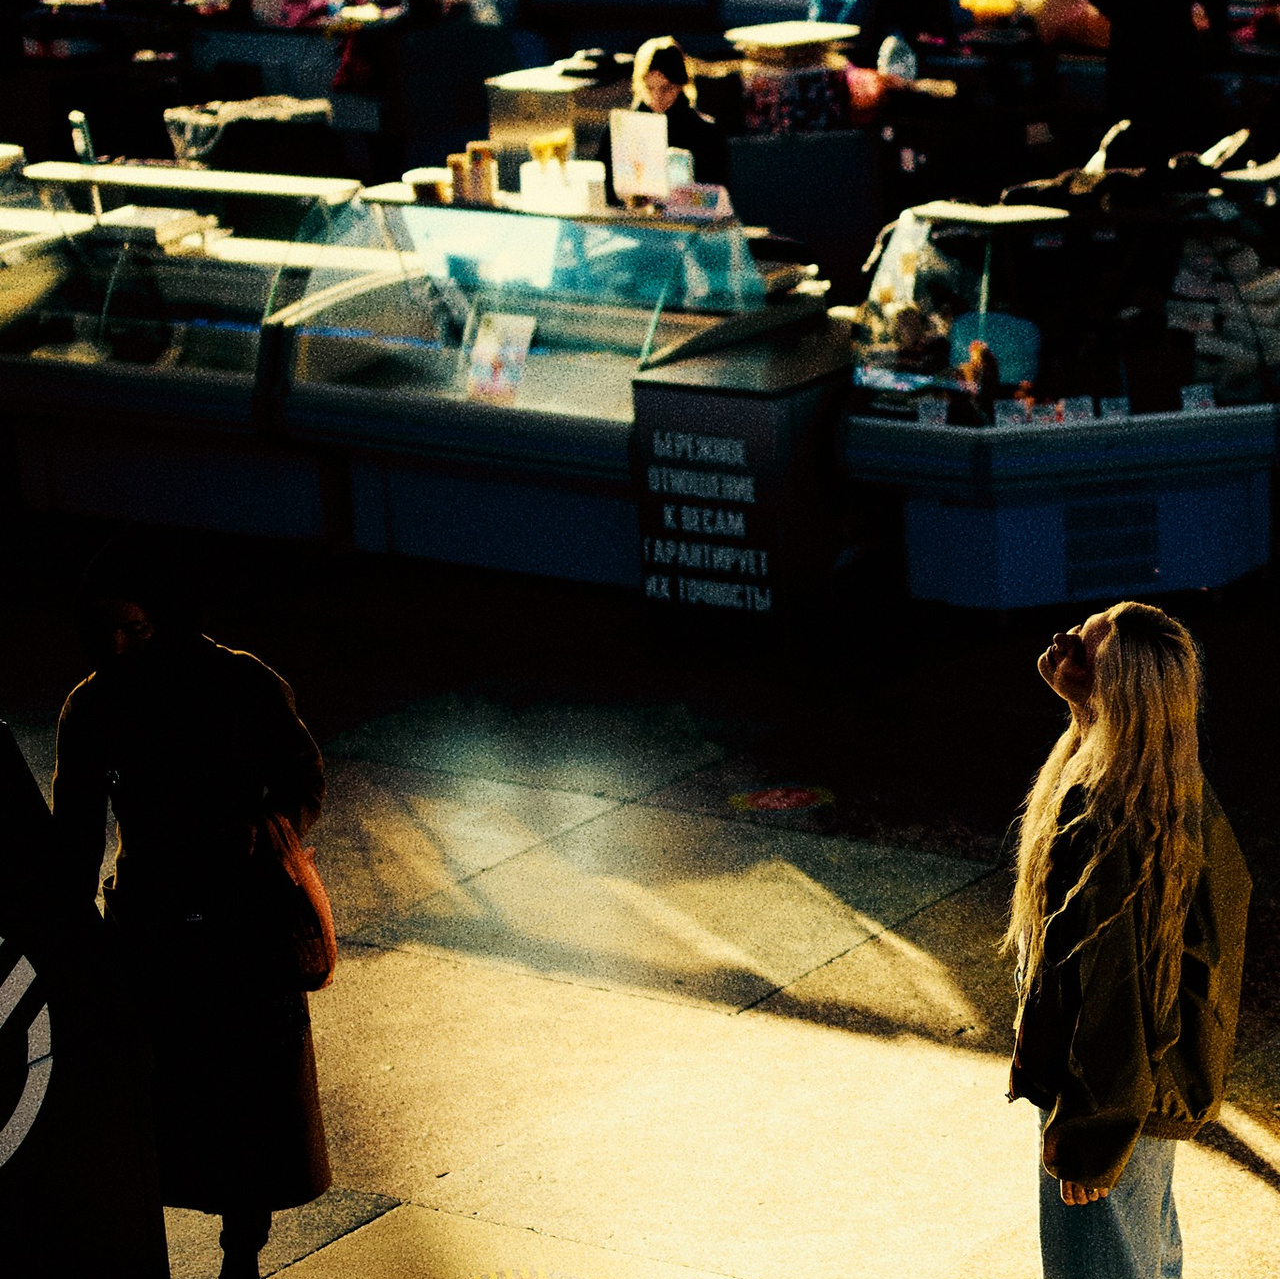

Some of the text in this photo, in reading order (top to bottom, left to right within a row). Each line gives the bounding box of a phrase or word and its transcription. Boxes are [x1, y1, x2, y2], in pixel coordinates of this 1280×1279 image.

[653, 431, 745, 466] БЕРЕЖНОЕ
[648, 467, 755, 504] ОТНОШЕНИЕ
[662, 503, 746, 540] К ВЕСАМ
[643, 537, 769, 576] ГАРАНТИРУЕТ
